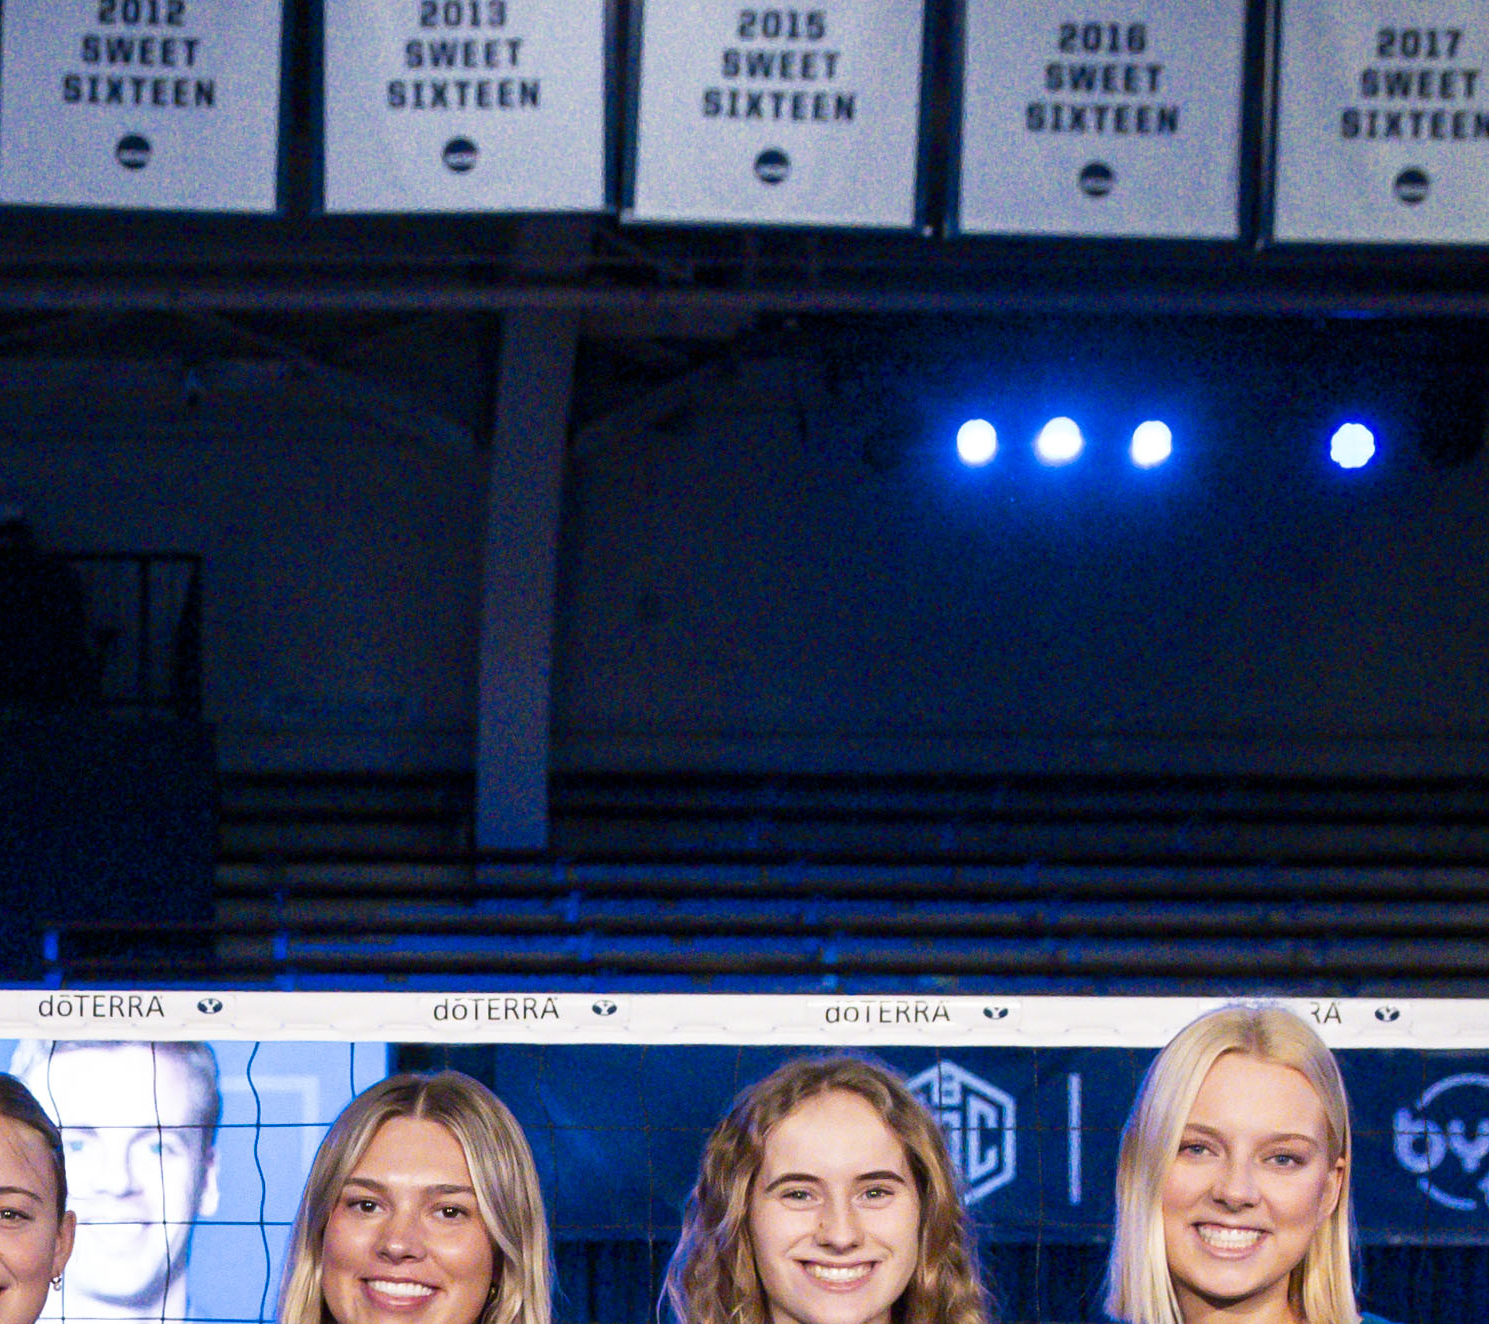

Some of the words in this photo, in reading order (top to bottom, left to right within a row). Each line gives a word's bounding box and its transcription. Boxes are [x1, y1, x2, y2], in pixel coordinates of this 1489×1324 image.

[98, 0, 185, 26] 2012
[420, 0, 506, 28] 2013
[738, 10, 825, 41] 2015
[82, 34, 199, 66] SWEET
[405, 39, 521, 68] SWEET
[1377, 28, 1462, 58] 2017
[723, 49, 839, 80] SWEET
[1046, 63, 1162, 93] SWEET
[63, 74, 214, 107] SIXTEEN
[388, 80, 539, 109] SIXTEEN
[1361, 69, 1478, 99] SWEET
[704, 89, 855, 121] SIXTEEN
[1027, 103, 1178, 134] SIXTEEN
